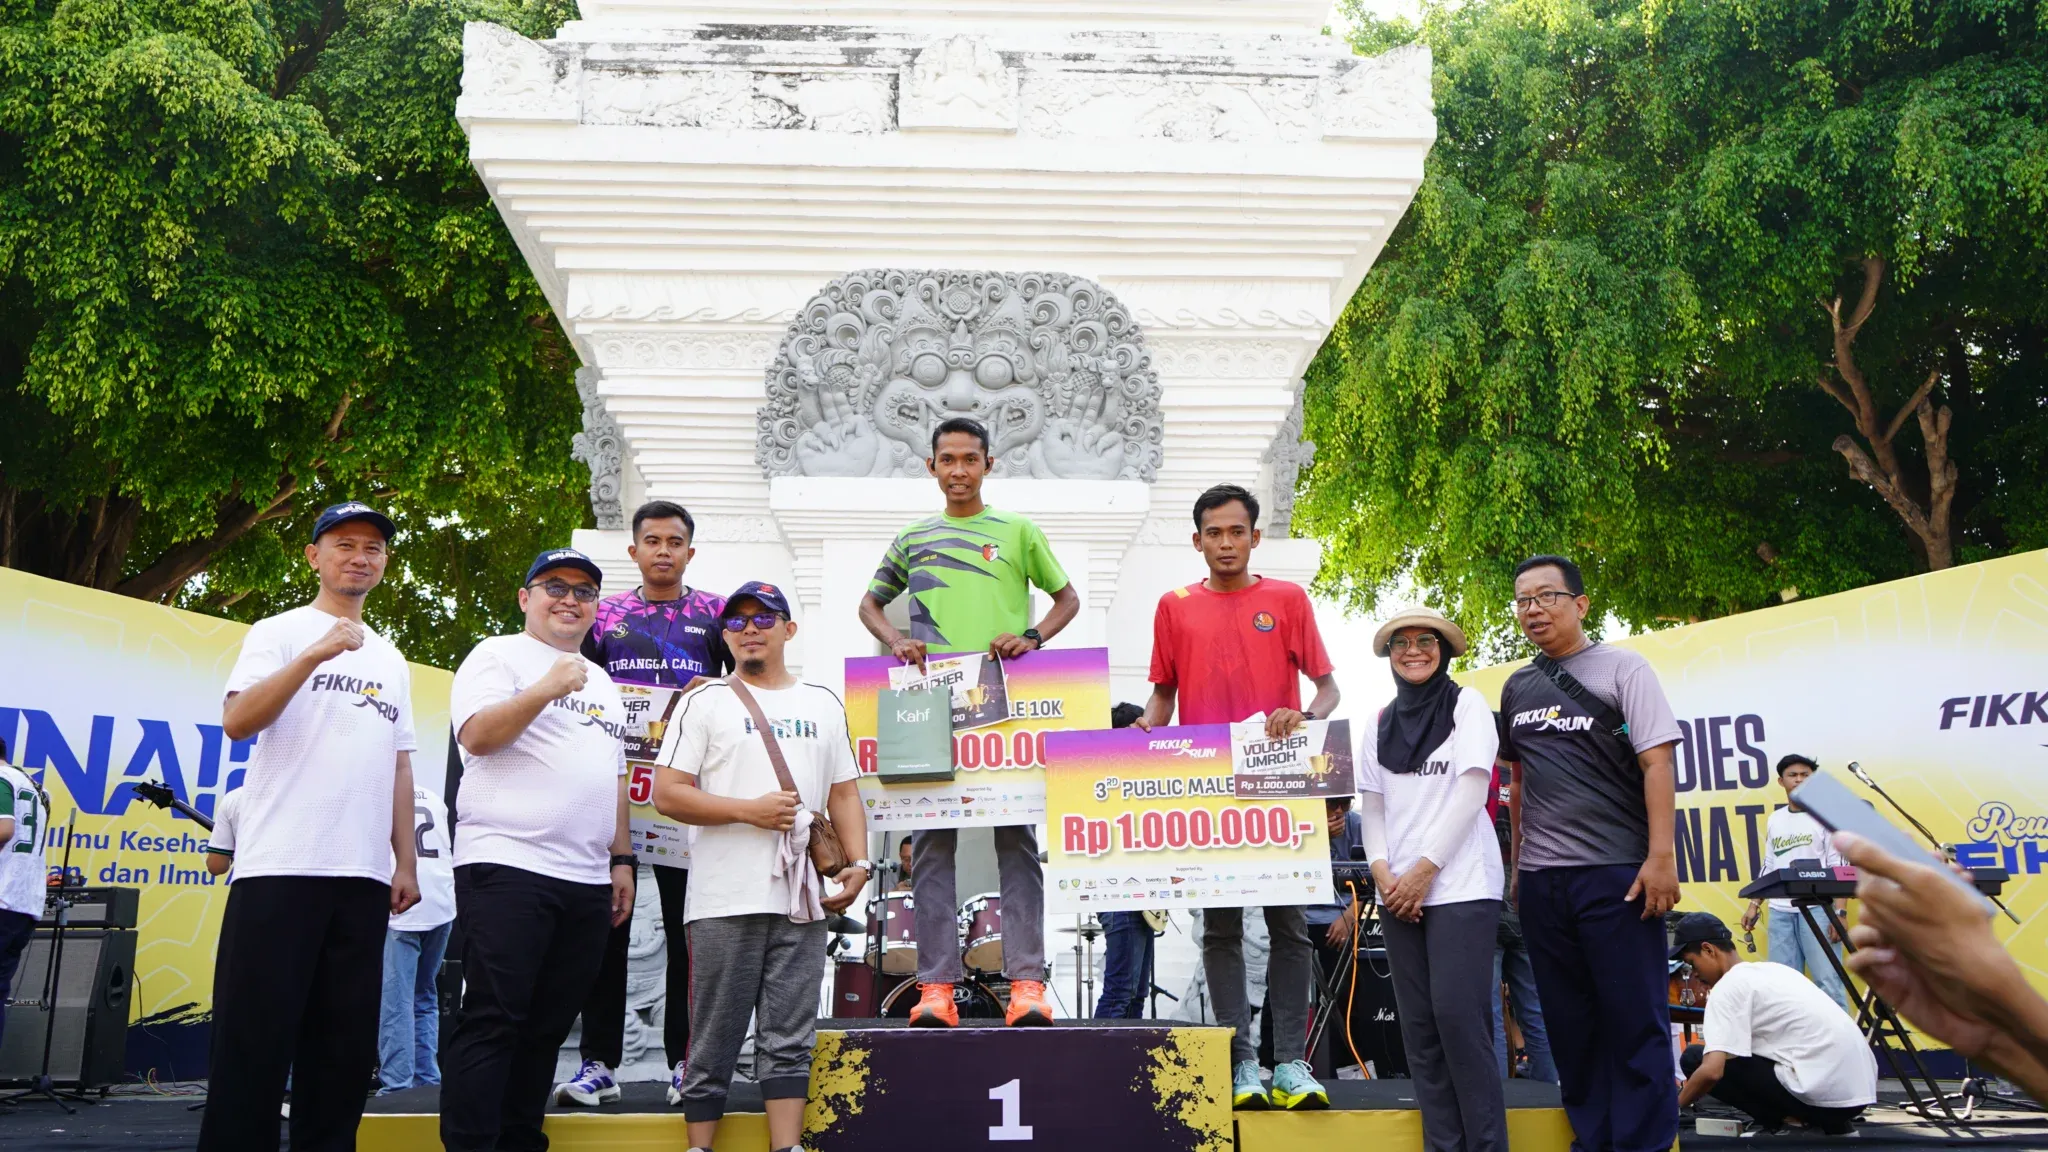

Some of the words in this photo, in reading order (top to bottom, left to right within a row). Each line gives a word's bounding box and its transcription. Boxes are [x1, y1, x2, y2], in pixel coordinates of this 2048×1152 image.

[684, 625, 706, 636] SONY
[608, 658, 669, 673] TURANGGA
[896, 708, 931, 723] Kahf
[1010, 700, 1025, 717] LE
[1030, 699, 1062, 717] 10K
[552, 696, 599, 717] IKKIA
[604, 721, 627, 742] RU
[1557, 716, 1594, 732] RUN
[858, 739, 878, 773] R
[1190, 747, 1217, 759] RUN
[1242, 735, 1308, 756] VOUCHER
[1673, 713, 1770, 793] DIES
[1246, 750, 1297, 769] UMROH
[1122, 778, 1184, 798] PUBLIC
[1188, 776, 1235, 796] MALE
[1240, 780, 1255, 791] Rp
[1255, 780, 1306, 790] 1.000.000
[48, 826, 110, 850] Ilmu
[119, 830, 211, 854] Keseha
[1064, 815, 1110, 855] Rp
[1116, 806, 1313, 849] 1.000.000,-
[1674, 803, 1788, 884] NAT
[1771, 832, 1813, 851] Medicine
[99, 862, 150, 884] dan
[158, 863, 216, 886] Ilmu
[988, 1078, 1034, 1141] 1
